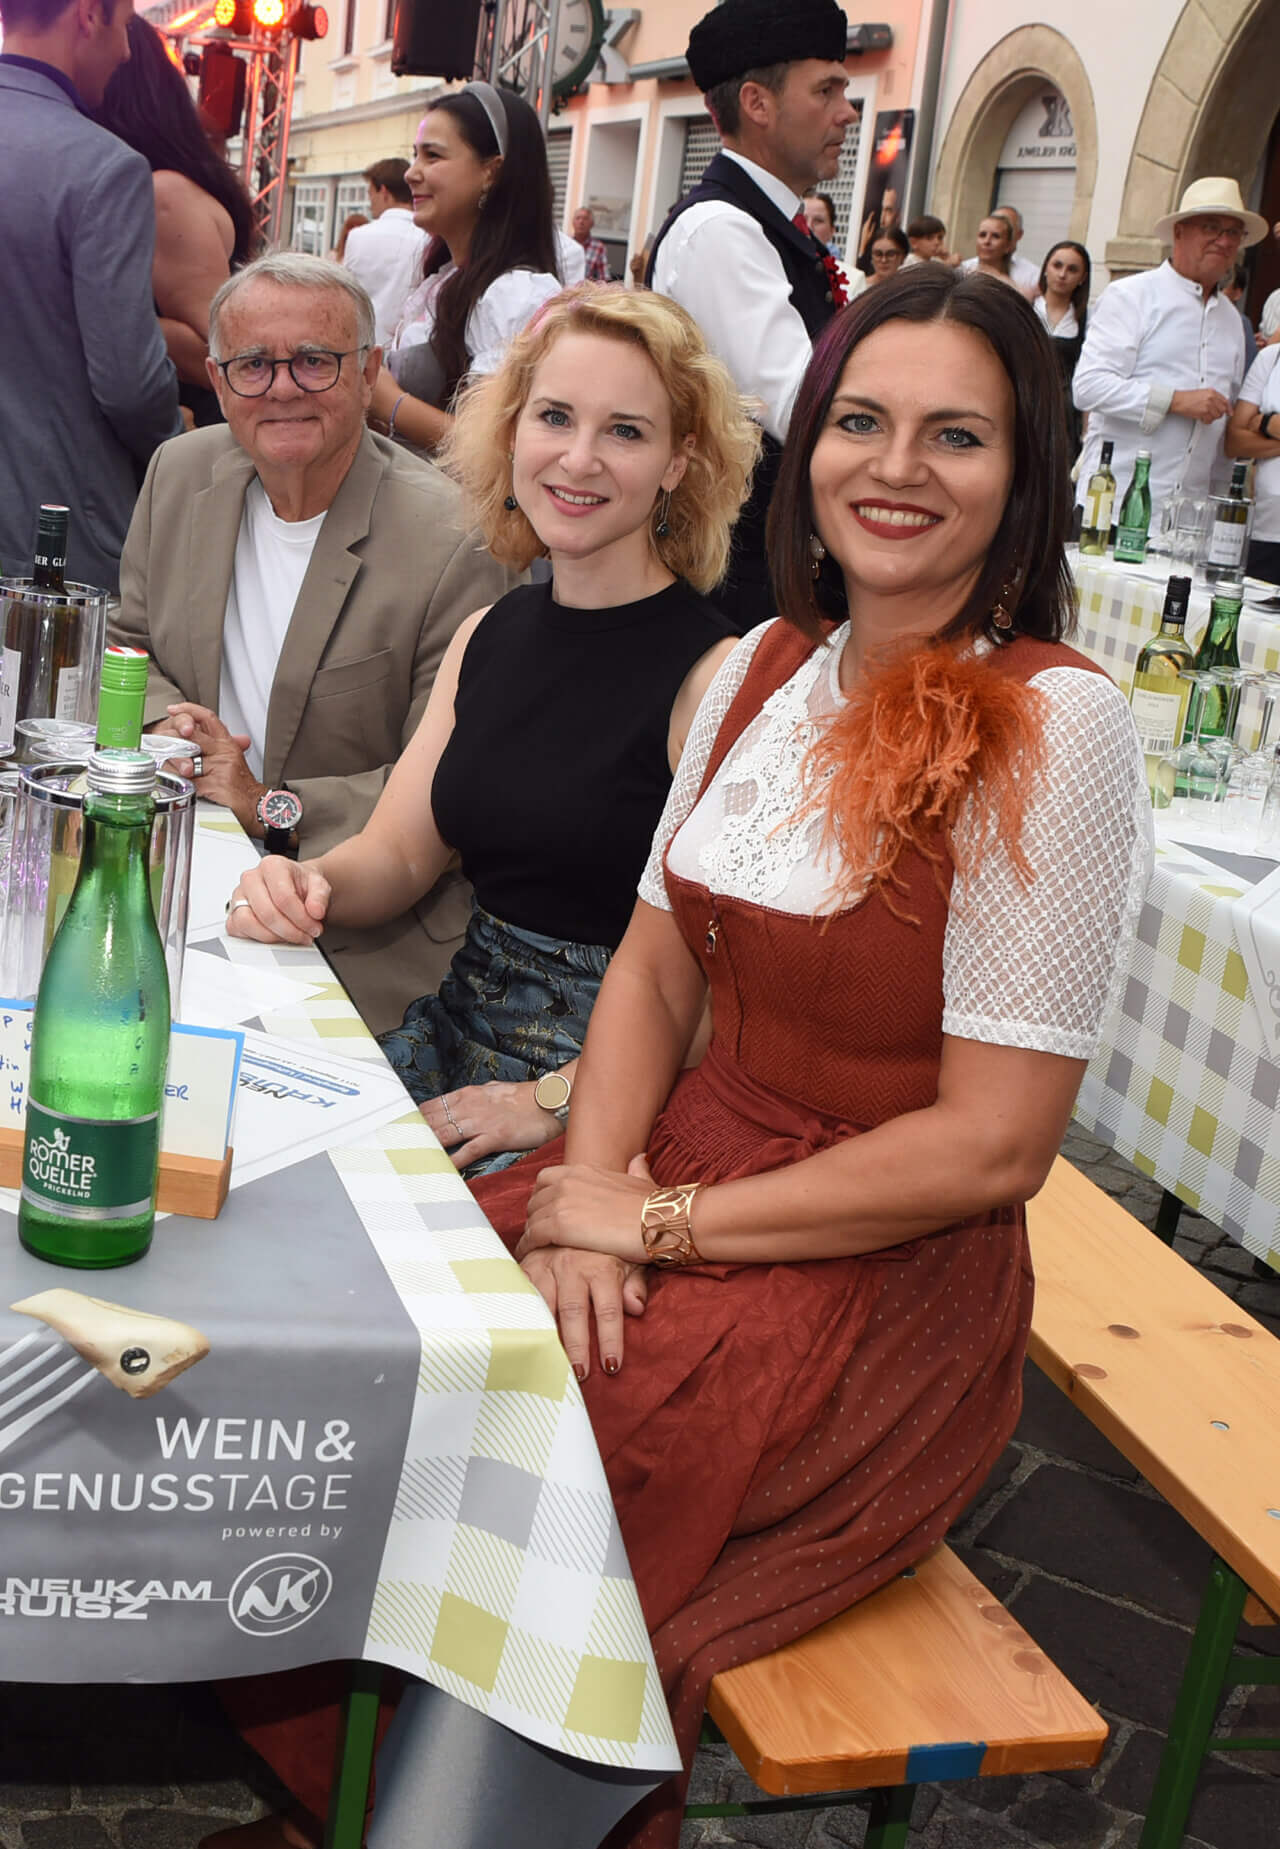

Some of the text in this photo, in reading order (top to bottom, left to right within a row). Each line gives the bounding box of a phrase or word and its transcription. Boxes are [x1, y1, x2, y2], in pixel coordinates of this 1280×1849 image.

[29, 1158, 93, 1190] QUELLE
[43, 1182, 91, 1199] PRICKELND
[222, 1523, 343, 1541] powered by
[4, 1577, 213, 1601] NEUKAM
